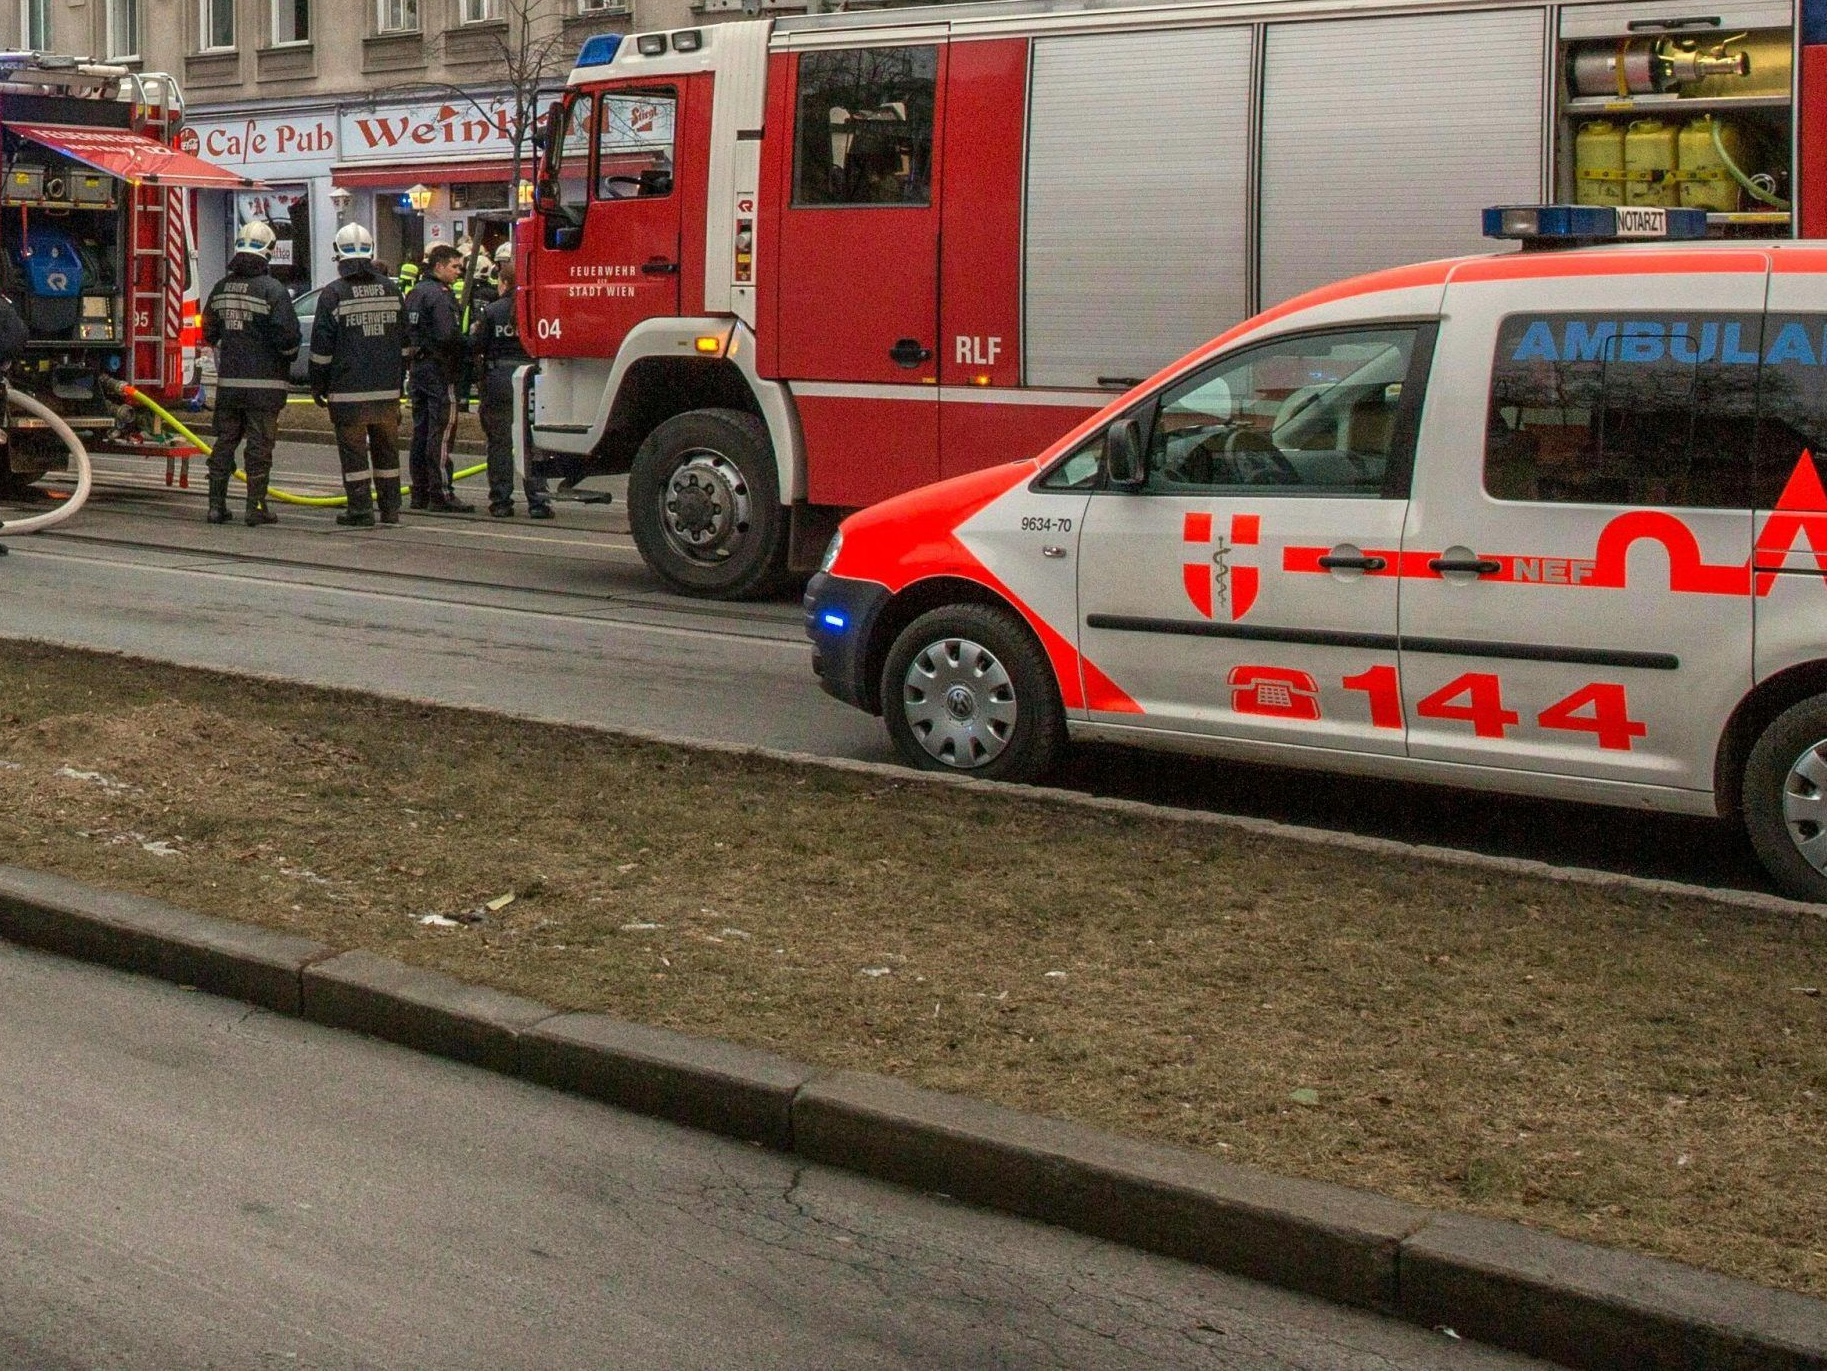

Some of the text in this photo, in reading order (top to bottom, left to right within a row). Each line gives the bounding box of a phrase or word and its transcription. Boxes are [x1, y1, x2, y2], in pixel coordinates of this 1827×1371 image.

[275, 122, 334, 154] Pub
[1617, 210, 1665, 232] NOTARZT
[570, 265, 637, 277] FEUERWEHR
[351, 283, 385, 297] BERUFS
[569, 286, 636, 297] STADT WIEN
[132, 311, 149, 327] 95
[345, 311, 398, 327] FEUERWEHR
[362, 323, 385, 336] WIEN
[495, 325, 518, 338] PO
[537, 318, 562, 339] 04
[955, 335, 1002, 365] RLF
[1511, 320, 1827, 366] AMBULA
[1021, 516, 1072, 533] 9634-70
[1513, 558, 1596, 585] NEF
[1342, 665, 1647, 752] 144
